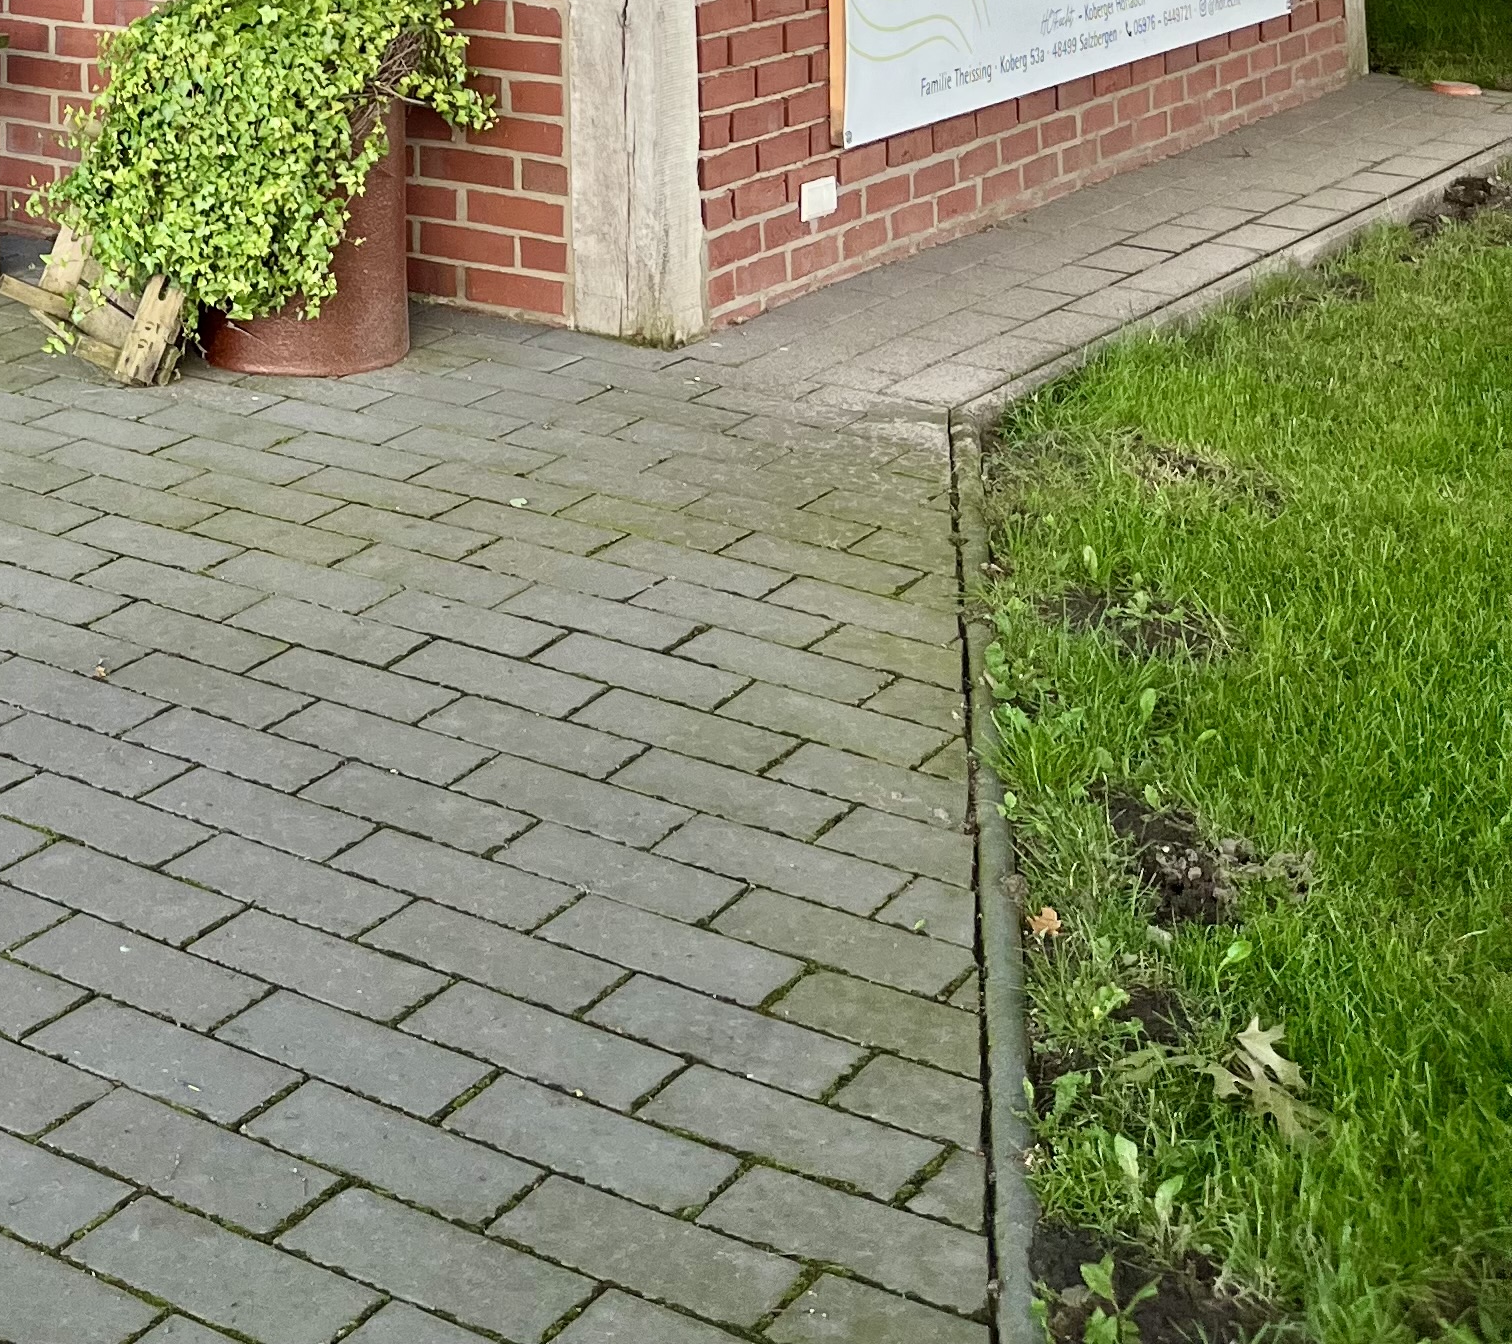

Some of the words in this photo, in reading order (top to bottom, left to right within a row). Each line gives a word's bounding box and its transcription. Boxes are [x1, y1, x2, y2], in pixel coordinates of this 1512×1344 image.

[1084, 1, 1114, 22] Koberger
[920, 69, 952, 98] Familie
[954, 61, 992, 88] Theissing
[999, 52, 1028, 75] Koberg
[1030, 47, 1045, 66] 53a
[1052, 36, 1078, 59] 48499
[1079, 29, 1118, 52] Salzbergen
